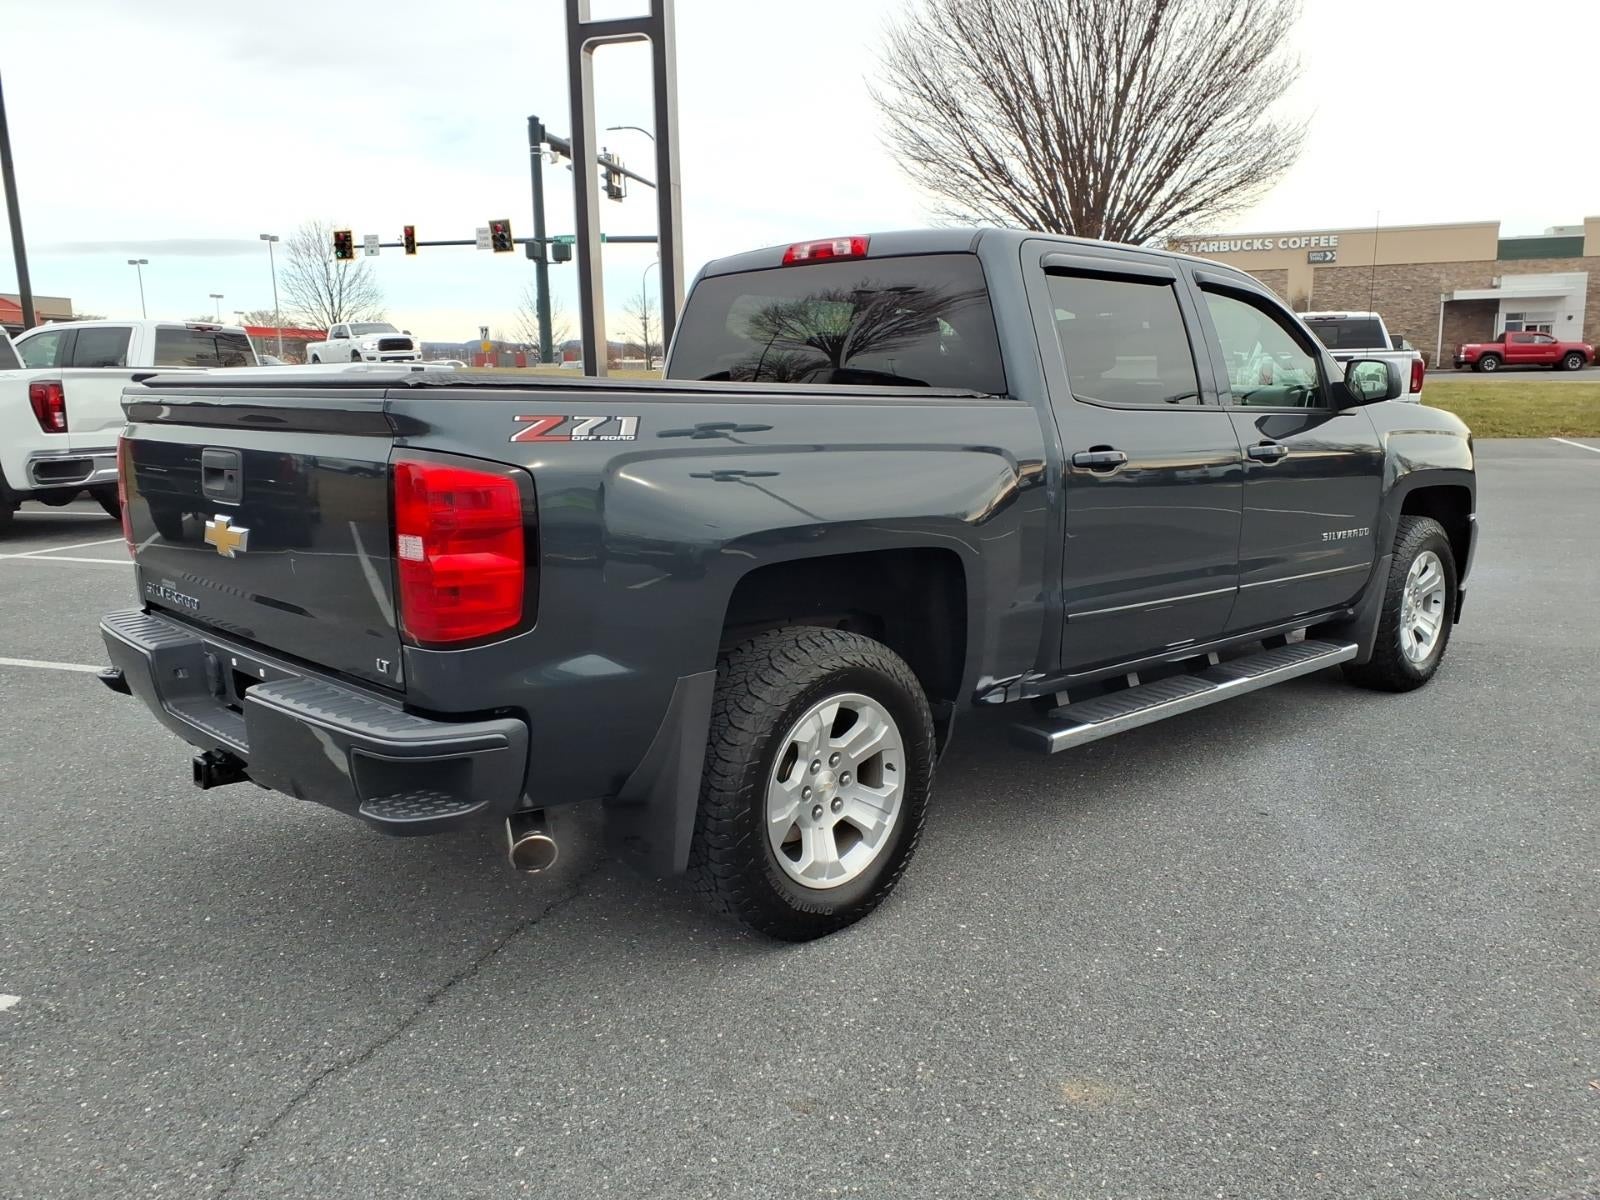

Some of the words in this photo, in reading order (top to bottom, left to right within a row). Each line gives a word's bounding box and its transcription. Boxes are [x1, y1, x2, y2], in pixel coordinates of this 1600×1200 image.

[1180, 238, 1274, 254] STARBUCKS
[1278, 235, 1338, 249] COFFEE
[509, 415, 641, 442] Z71
[1322, 527, 1370, 541] SILVERADO
[376, 658, 391, 675] LT
